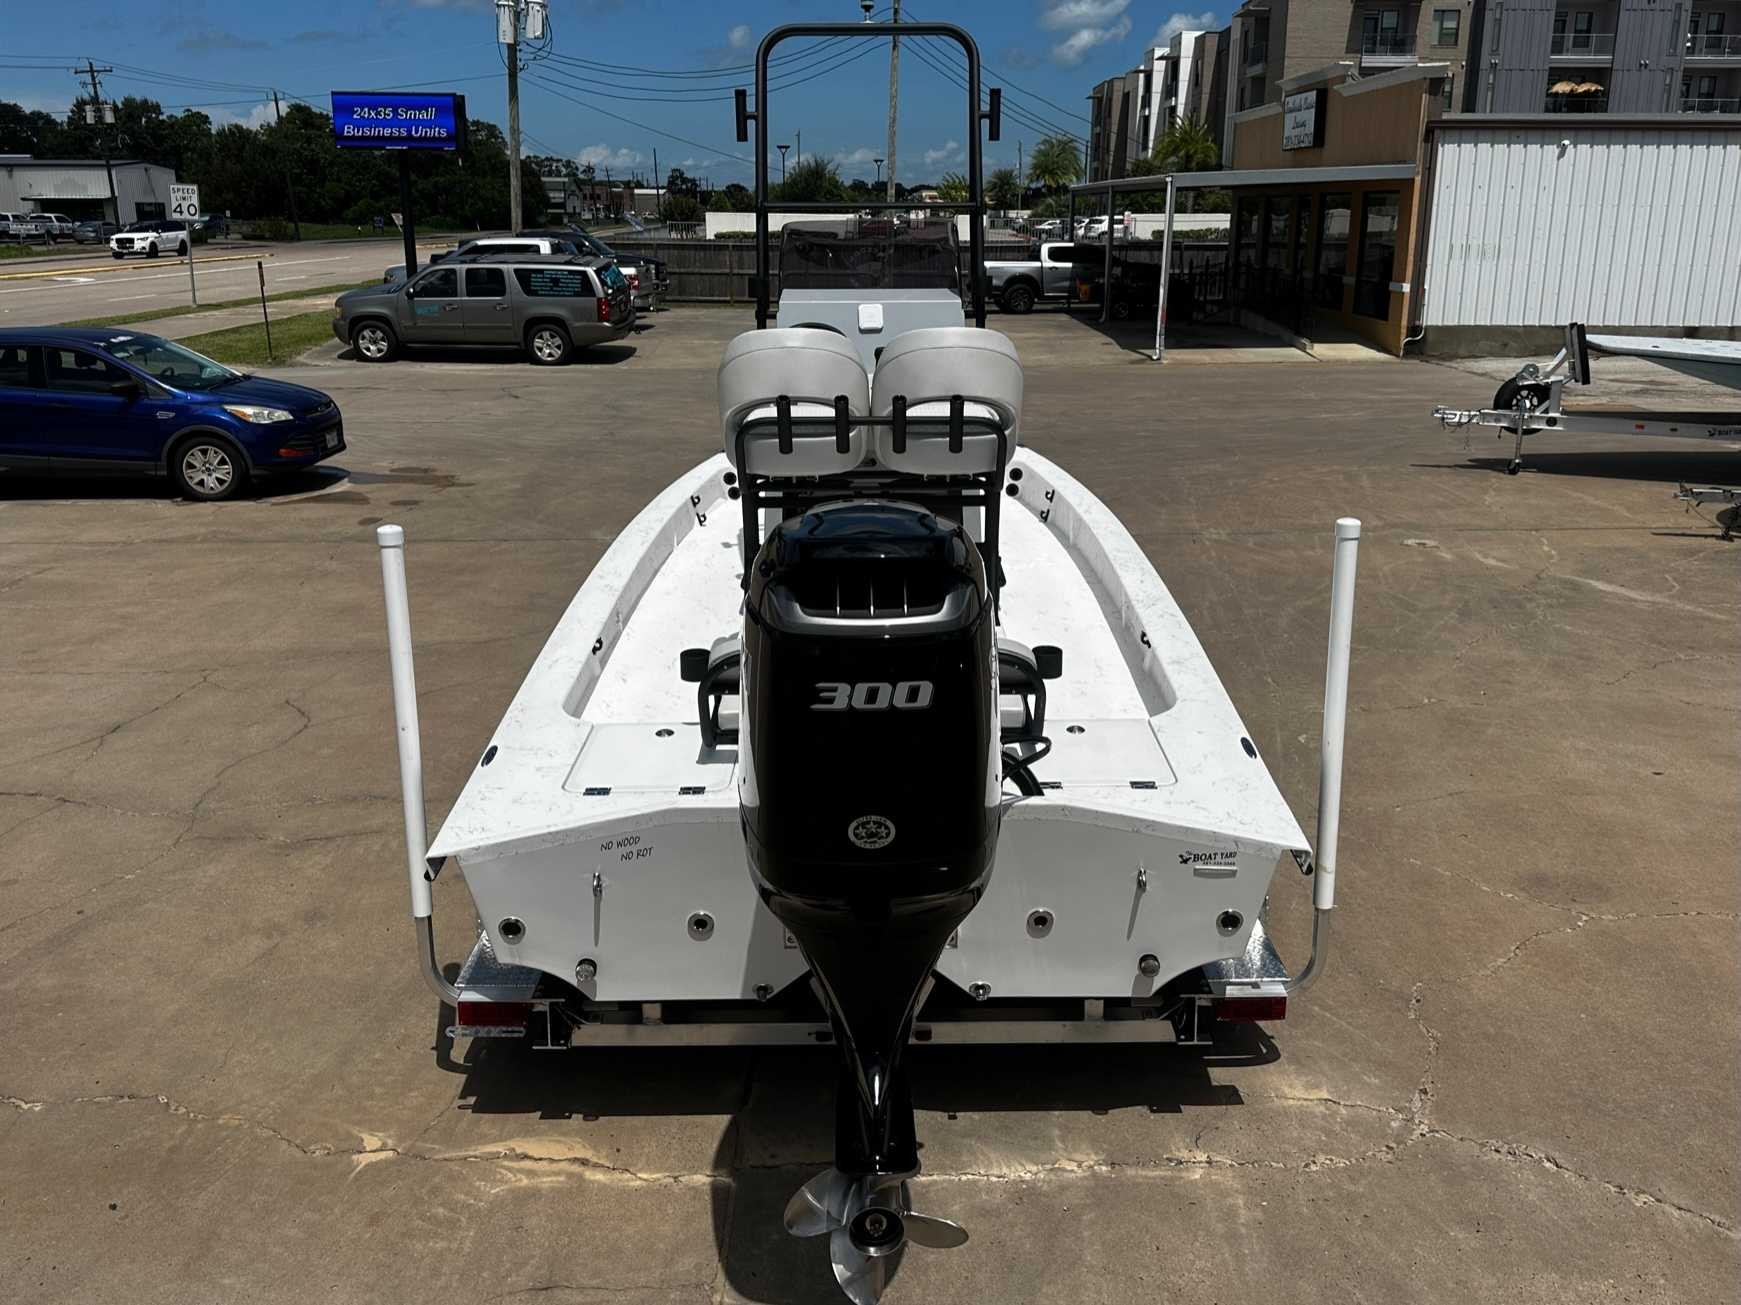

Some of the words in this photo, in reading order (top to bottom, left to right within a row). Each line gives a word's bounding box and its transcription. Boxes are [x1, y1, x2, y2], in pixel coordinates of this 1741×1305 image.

[352, 107, 393, 119] 24x35
[397, 107, 436, 120] Small
[343, 124, 407, 136] Business
[411, 125, 448, 137] Units
[171, 187, 196, 195] SPEED
[172, 202, 198, 217] 40
[810, 680, 933, 710] 300
[600, 840, 613, 852] NO
[616, 835, 641, 849] WOOD
[620, 850, 634, 862] NO
[636, 846, 654, 860] ROT
[1192, 852, 1219, 863] BOAT
[1220, 851, 1238, 860] YARD
